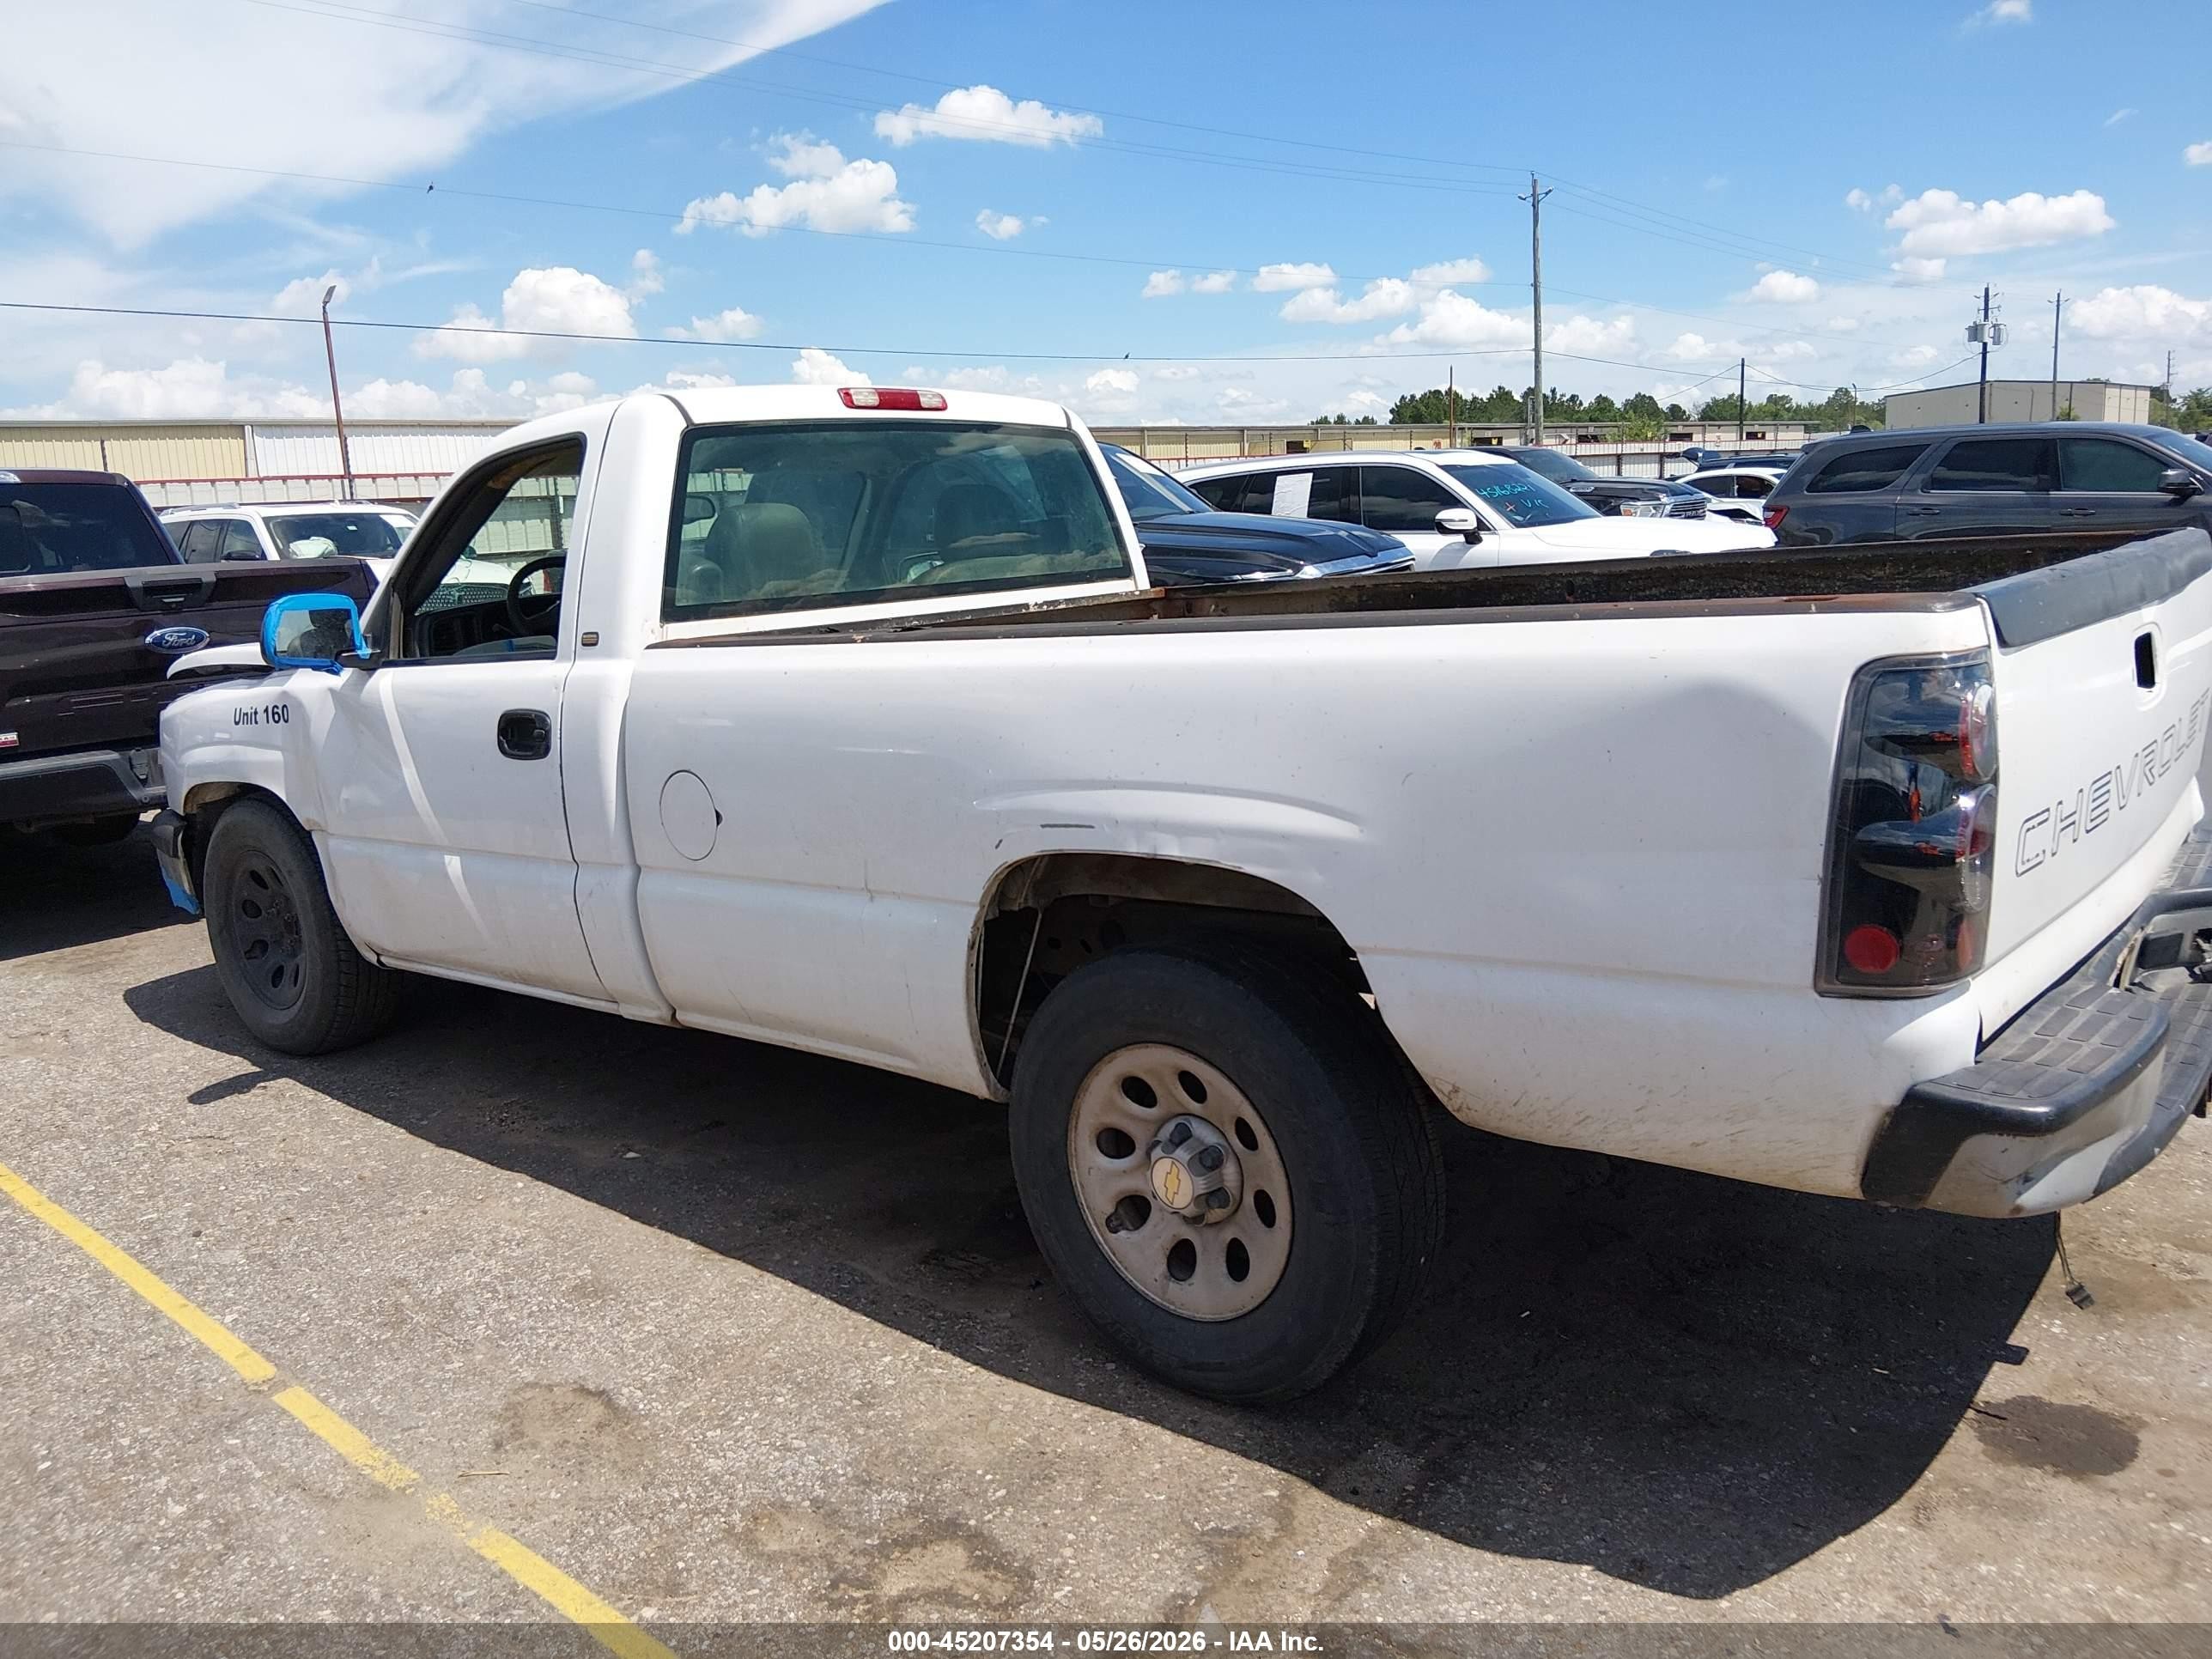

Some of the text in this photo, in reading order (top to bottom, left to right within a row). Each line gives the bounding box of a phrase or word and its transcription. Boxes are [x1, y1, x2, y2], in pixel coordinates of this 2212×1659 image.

[162, 632, 196, 647] Ford
[234, 704, 289, 726] Unit 160
[2015, 687, 2210, 878] CHEVROLET
